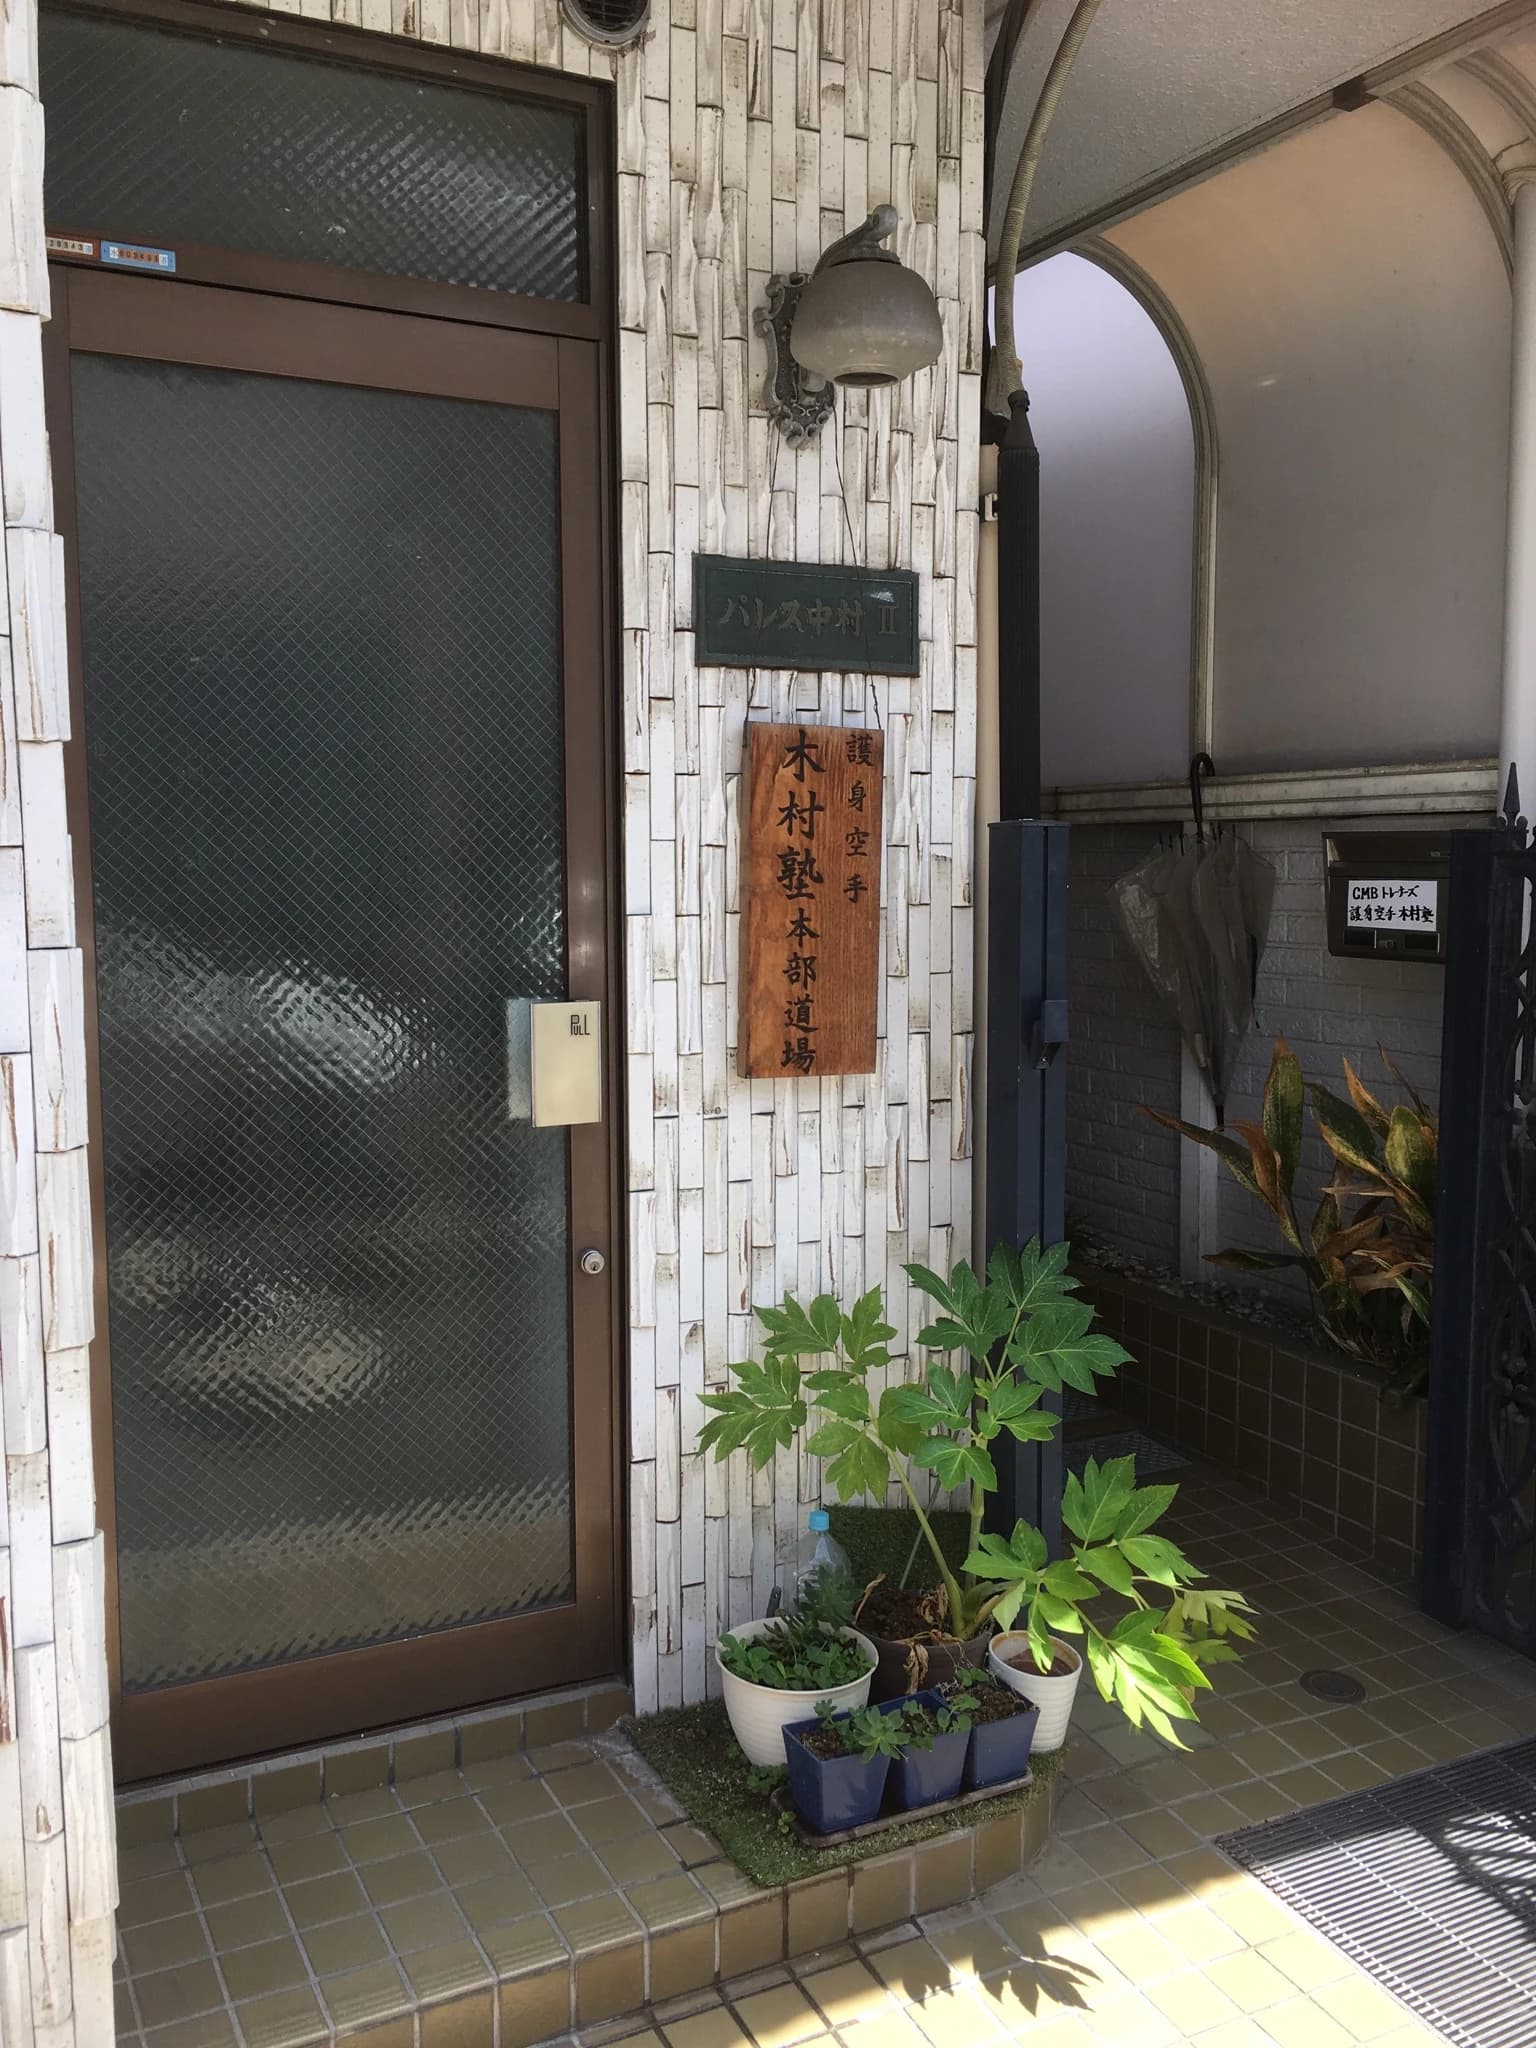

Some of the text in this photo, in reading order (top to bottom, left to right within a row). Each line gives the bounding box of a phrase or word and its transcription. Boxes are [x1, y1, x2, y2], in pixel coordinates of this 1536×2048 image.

[719, 594, 865, 638] パレス中村
[843, 734, 873, 904] 護身空手
[1352, 886, 1379, 900] CMB
[570, 1014, 591, 1036] PULL
